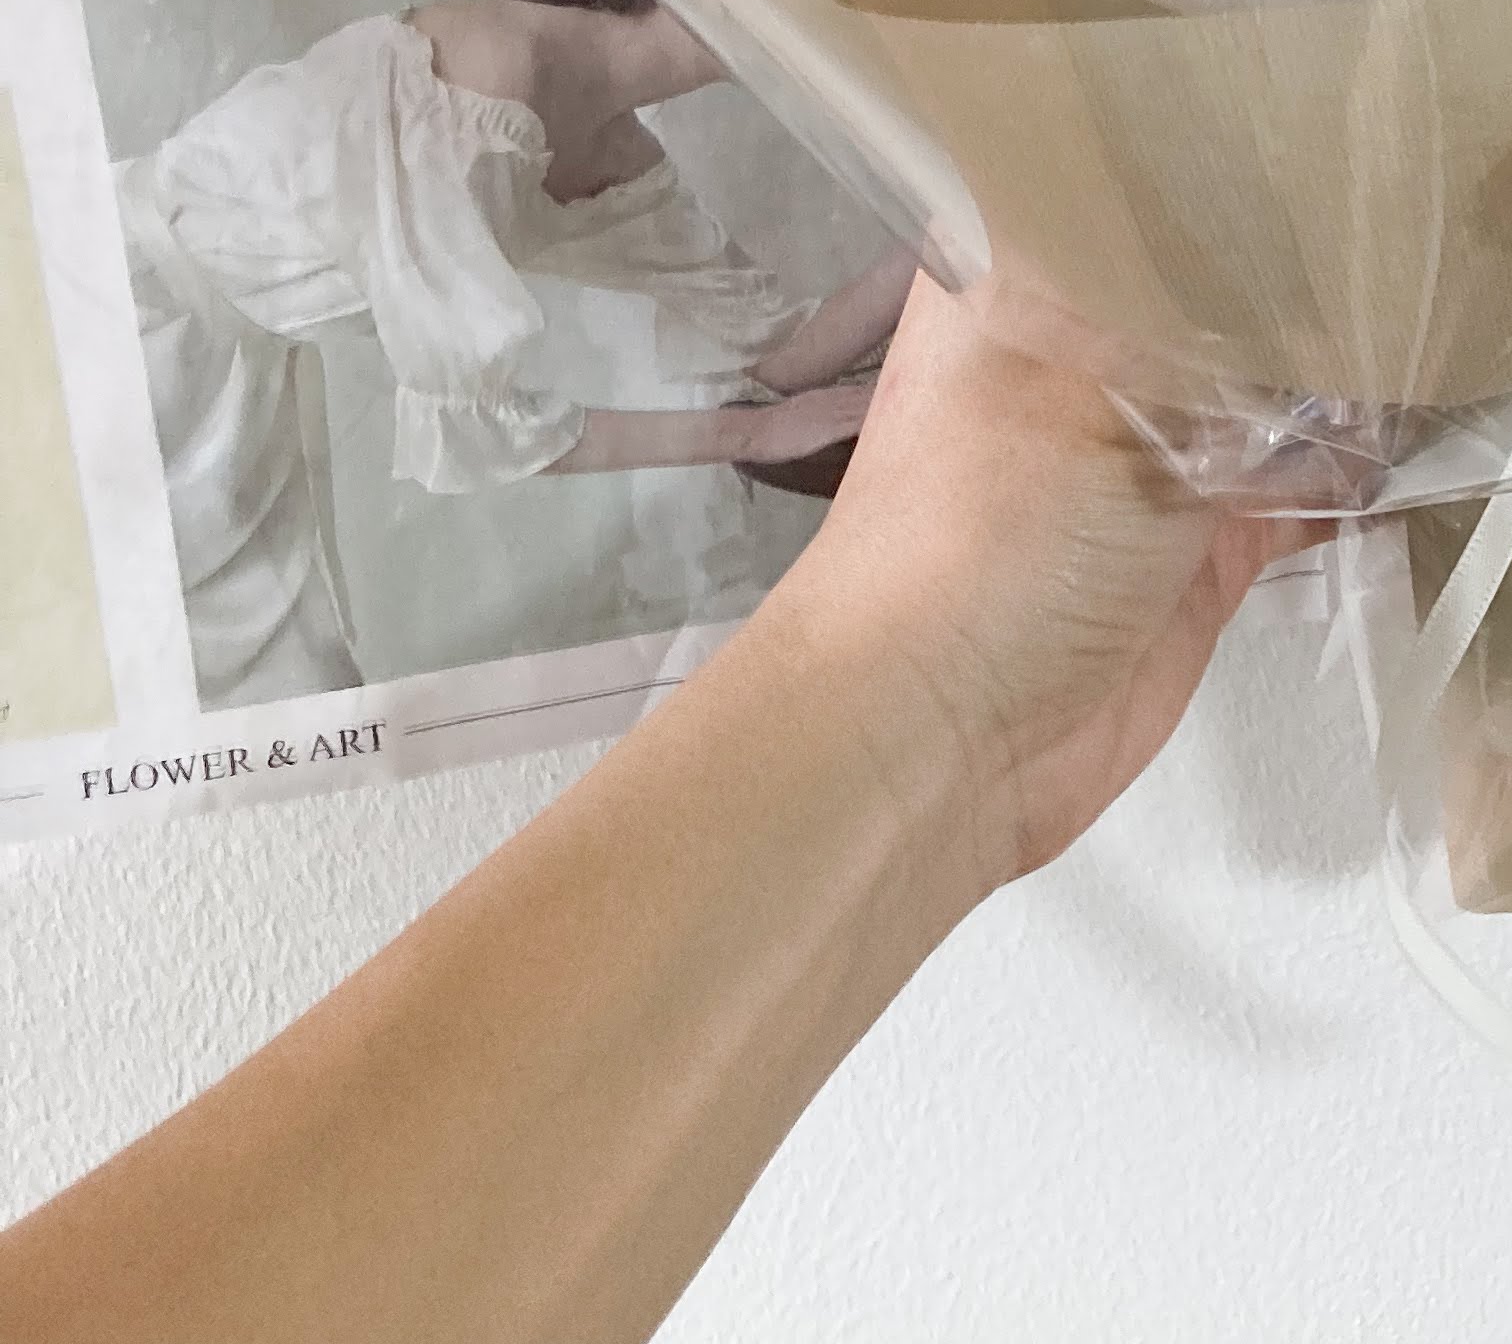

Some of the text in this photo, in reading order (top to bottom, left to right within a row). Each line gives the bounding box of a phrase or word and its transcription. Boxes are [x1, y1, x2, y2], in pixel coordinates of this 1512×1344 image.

[81, 722, 387, 800] FLOWER & ART
